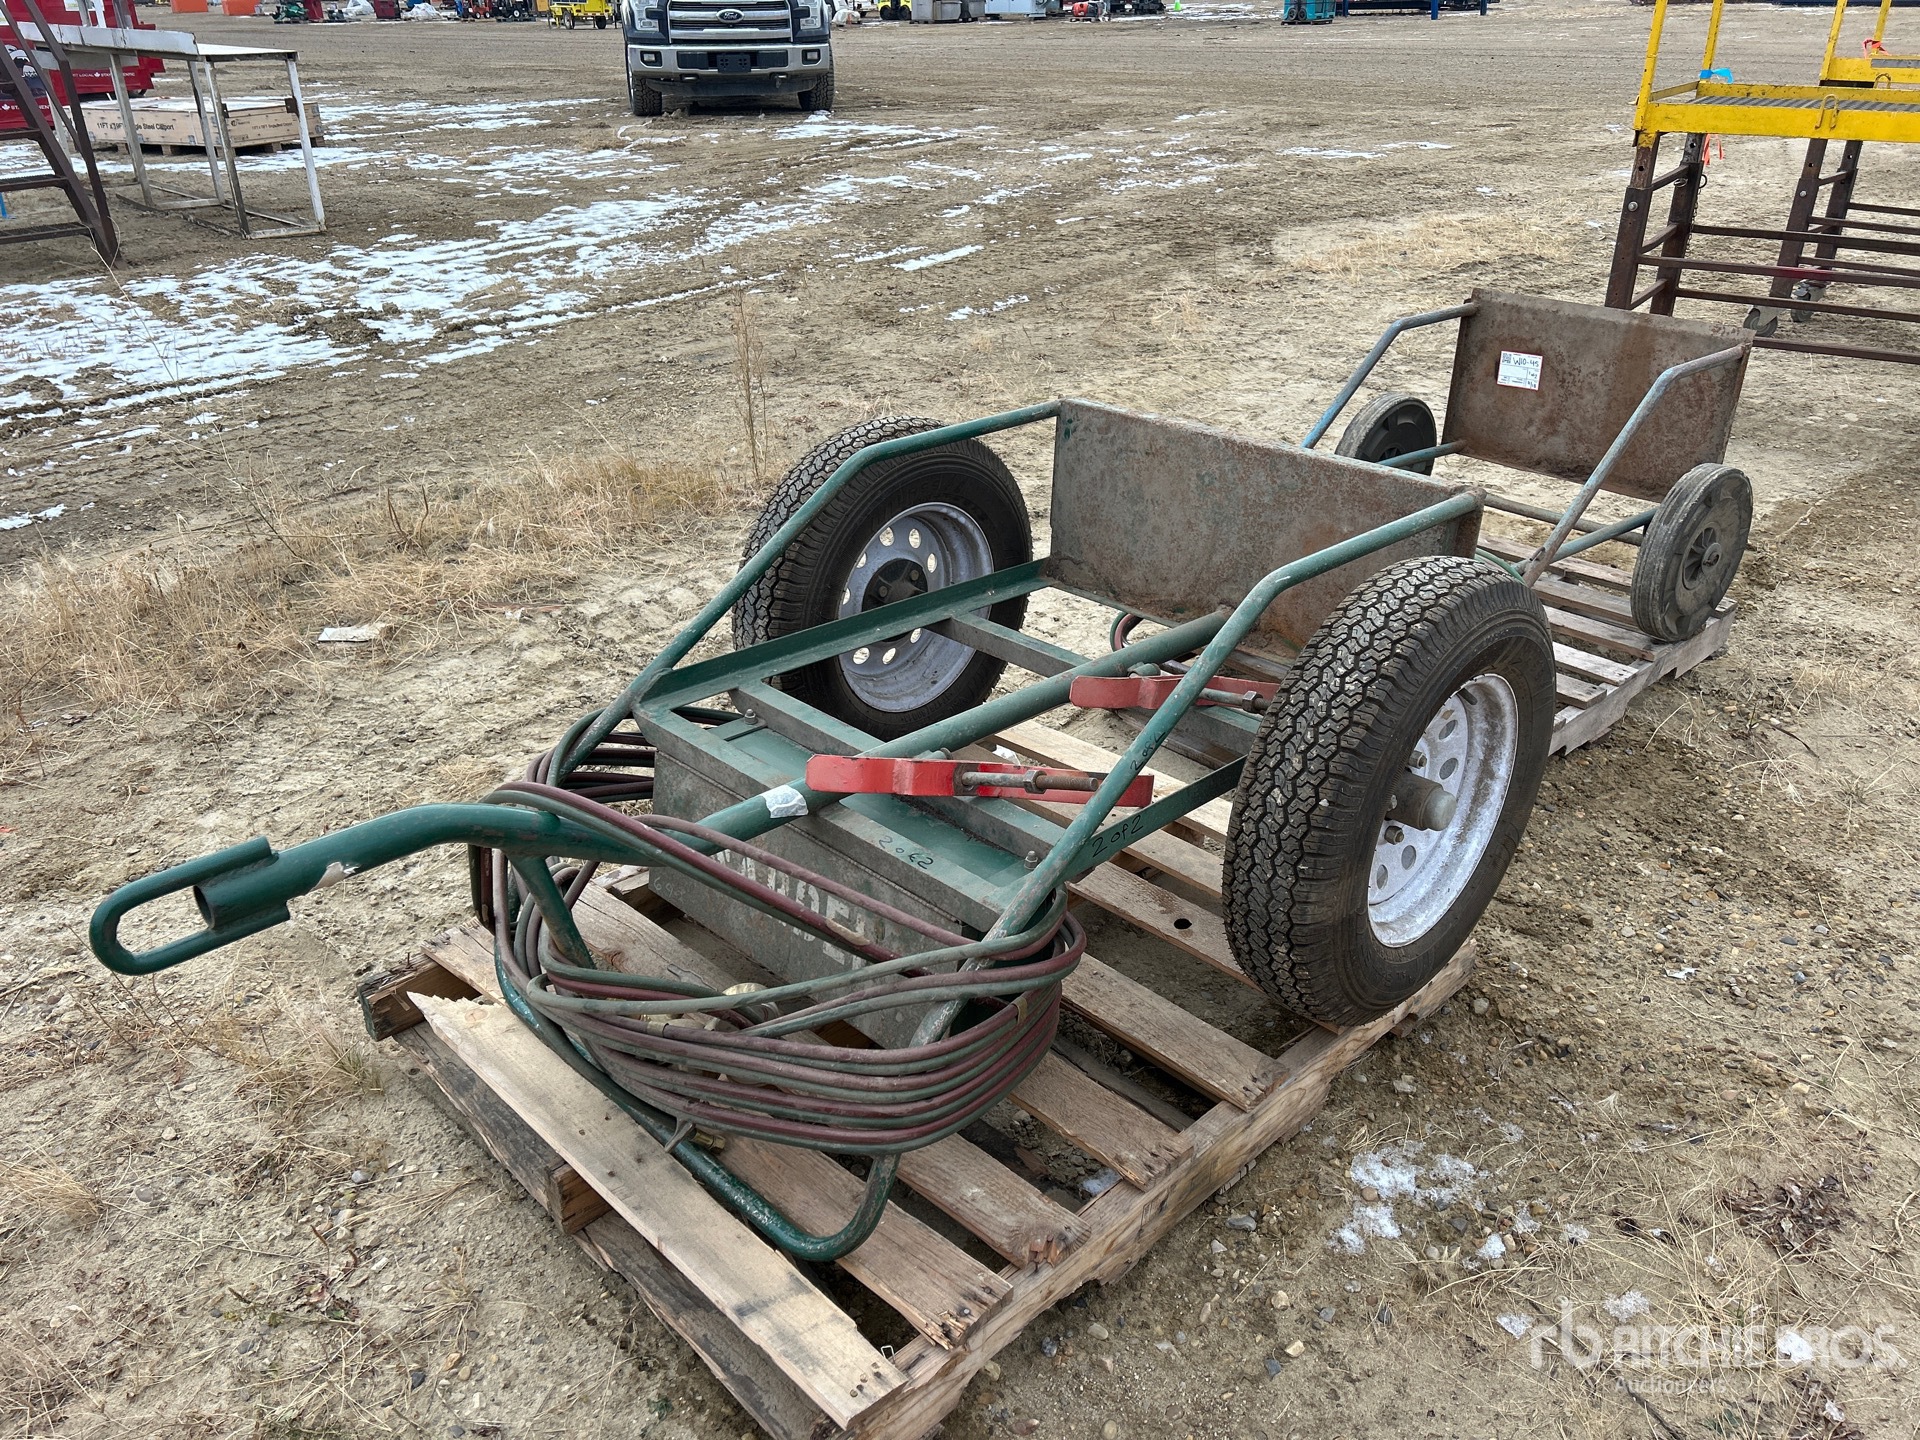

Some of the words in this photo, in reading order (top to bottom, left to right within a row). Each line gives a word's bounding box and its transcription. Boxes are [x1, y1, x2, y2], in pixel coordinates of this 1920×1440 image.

[723, 12, 738, 20] Ford
[1130, 760, 1144, 771] 2
[1092, 837, 1107, 858] 2
[1110, 823, 1129, 843] of
[1131, 814, 1144, 834] 2
[878, 835, 894, 849] 2
[917, 856, 934, 870] 2
